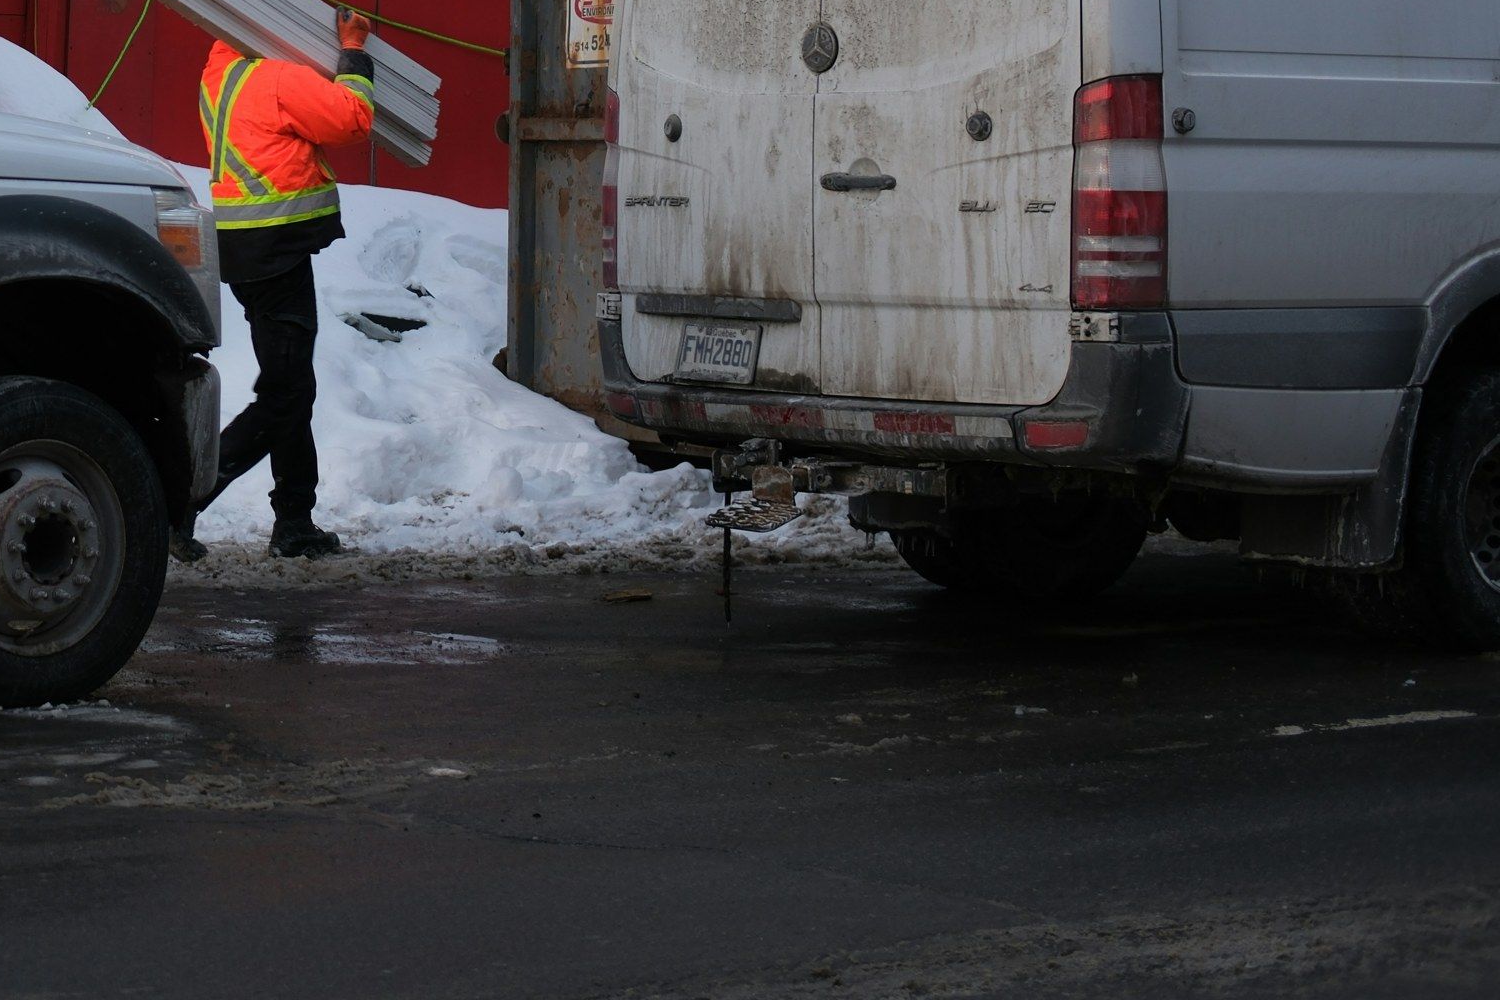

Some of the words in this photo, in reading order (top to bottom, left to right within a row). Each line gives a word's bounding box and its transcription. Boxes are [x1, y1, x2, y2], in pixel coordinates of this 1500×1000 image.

[575, 41, 589, 52] 514
[625, 195, 690, 208] SPRINTER
[682, 335, 753, 367] FMH2880
